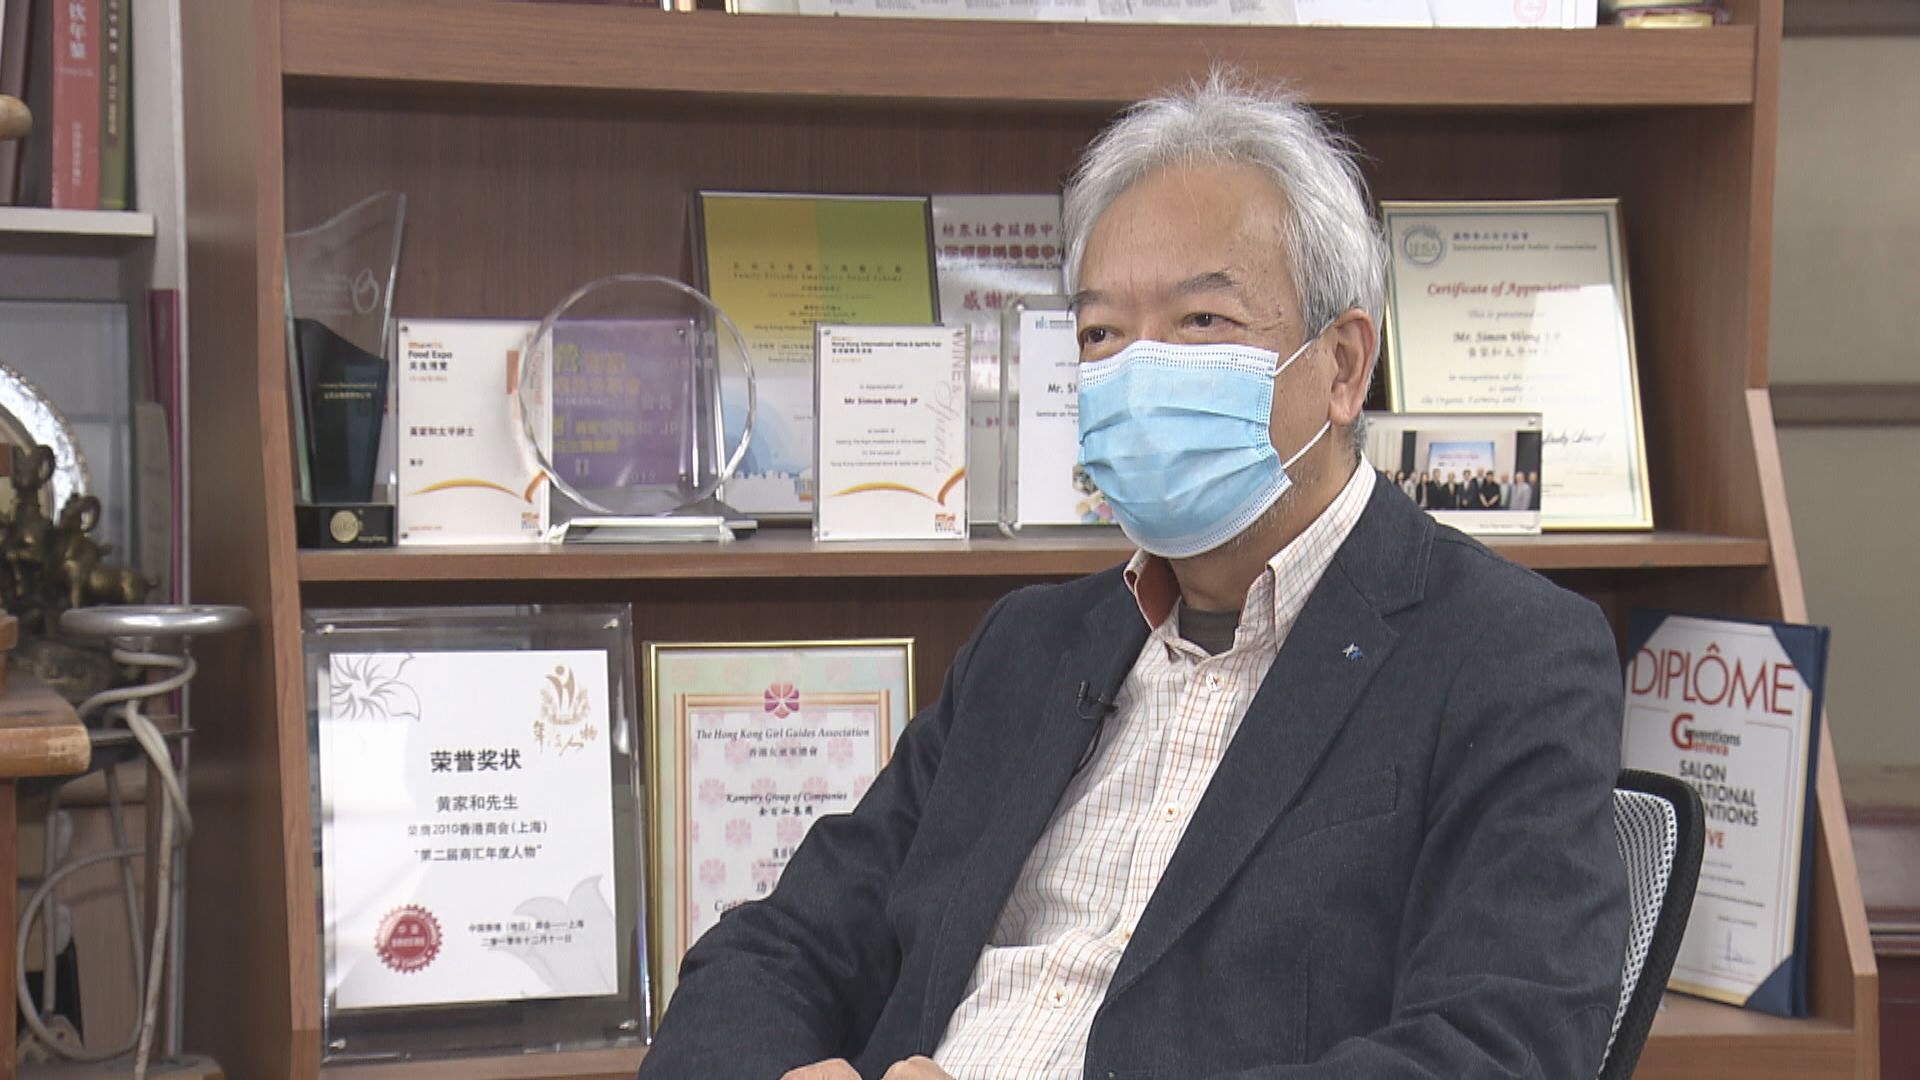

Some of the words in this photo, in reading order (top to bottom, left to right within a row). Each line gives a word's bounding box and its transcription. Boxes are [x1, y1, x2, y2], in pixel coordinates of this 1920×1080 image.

[1427, 281, 1488, 298] Certificate
[1491, 282, 1504, 297] of
[1476, 331, 1508, 343] Simon
[407, 350, 430, 360] Food
[431, 350, 453, 360] Expo
[1048, 383, 1064, 393] Mr.
[858, 397, 883, 405] Simon
[885, 397, 908, 407] Wong
[1631, 641, 1795, 716] DIPLÔME
[696, 729, 713, 740] The
[714, 729, 738, 741] Hong
[740, 729, 763, 741] Kong
[765, 728, 783, 738] Girl
[785, 728, 815, 738] Guides
[818, 727, 870, 738] Association
[430, 747, 523, 773] 荣誉奖状
[1679, 759, 1727, 783] SALON
[436, 793, 519, 813] 黄家和先生
[765, 792, 791, 805] Group
[793, 791, 802, 802] of
[803, 791, 848, 804] Companies
[1702, 801, 1759, 828] NTIONS
